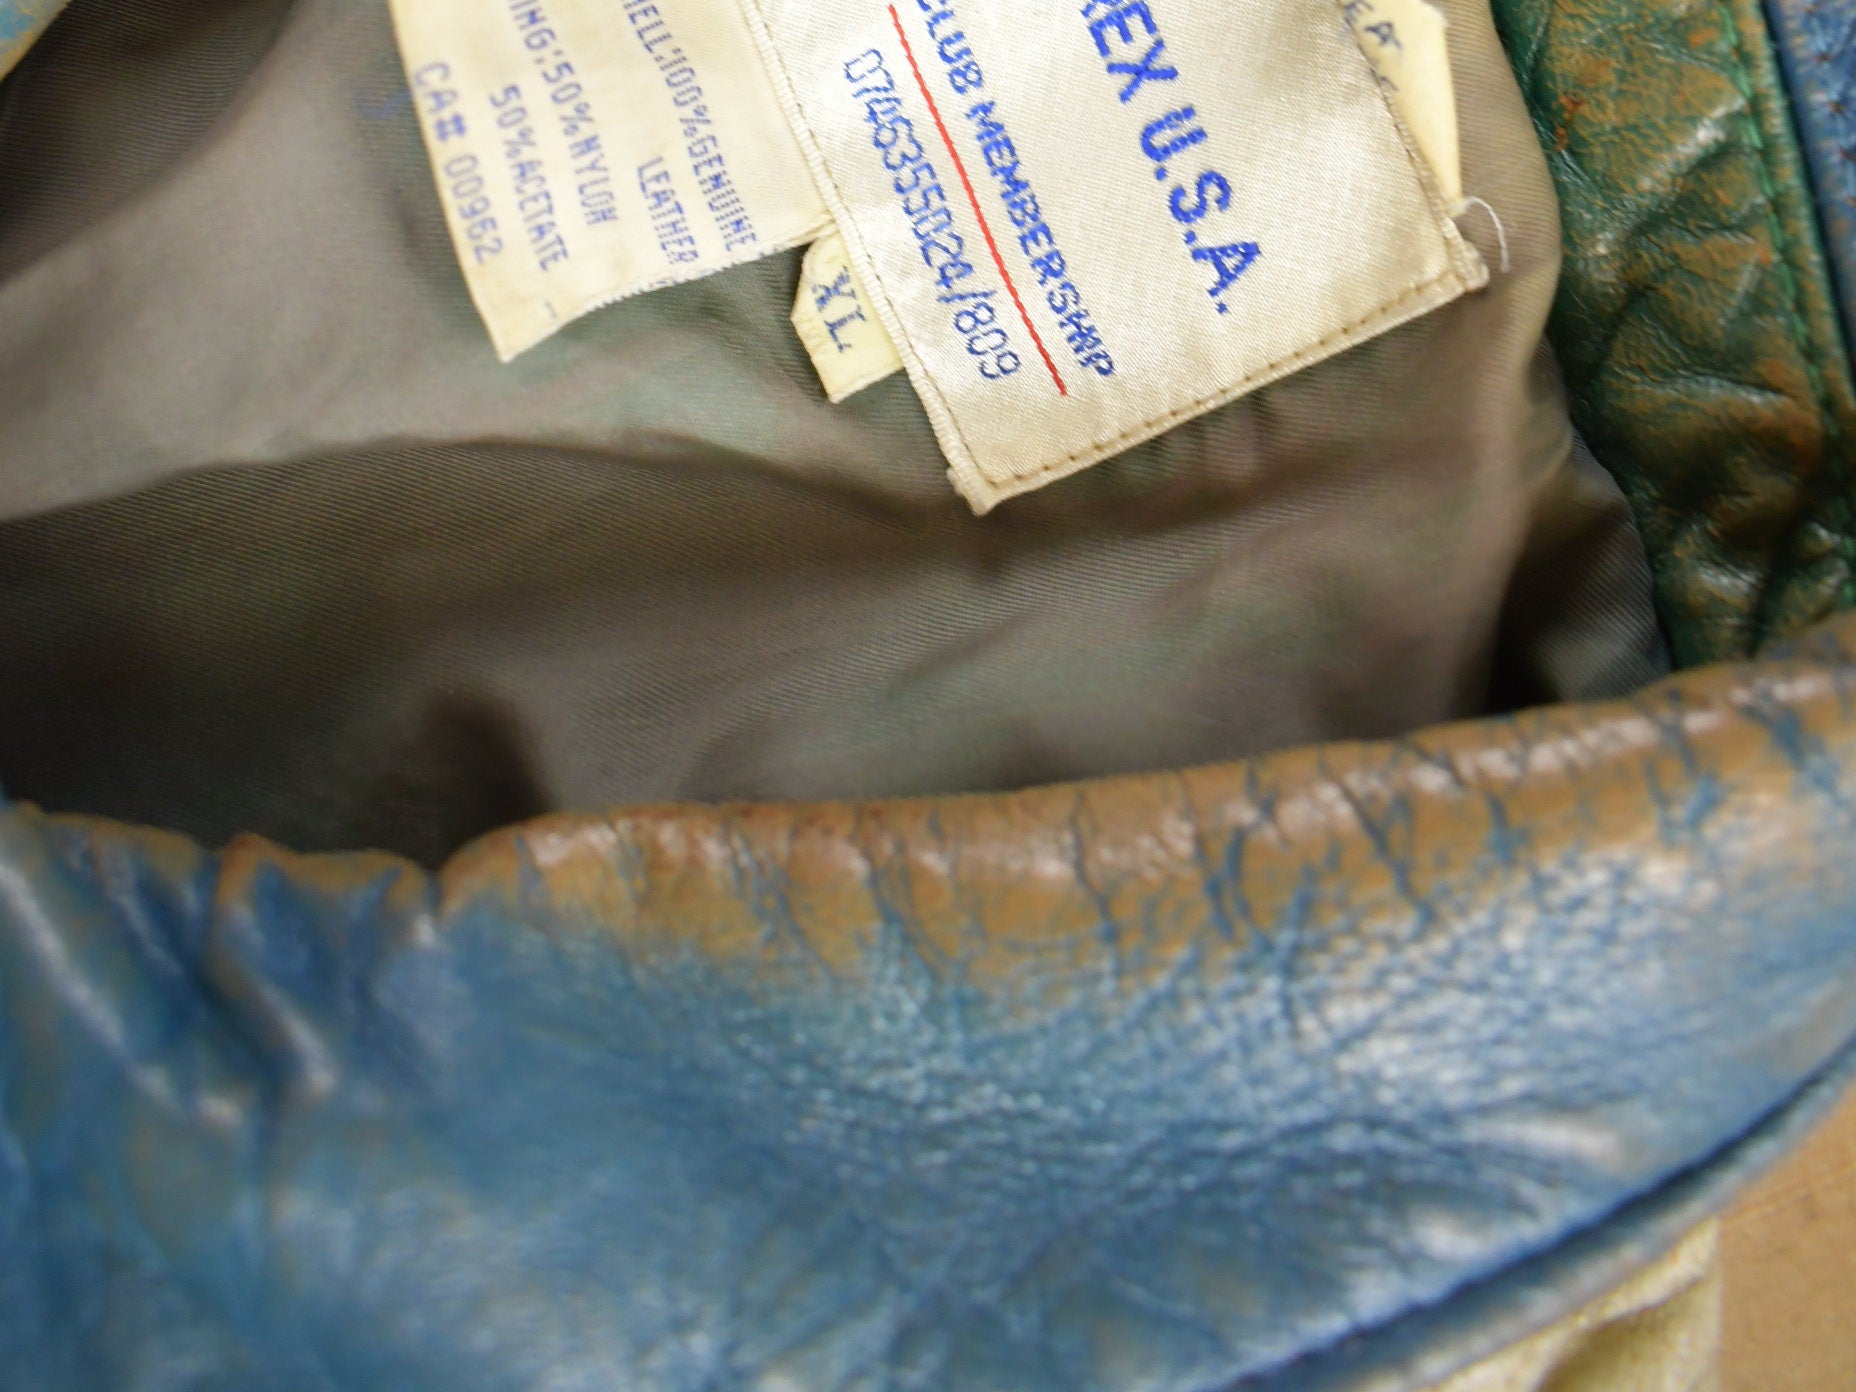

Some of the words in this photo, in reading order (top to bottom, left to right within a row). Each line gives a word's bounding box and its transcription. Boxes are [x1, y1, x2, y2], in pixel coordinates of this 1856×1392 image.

[444, 154, 503, 266] 00962
[637, 157, 700, 265] LEATHER
[966, 101, 1116, 376] MEMBERSHIP
[811, 266, 866, 353] XL
